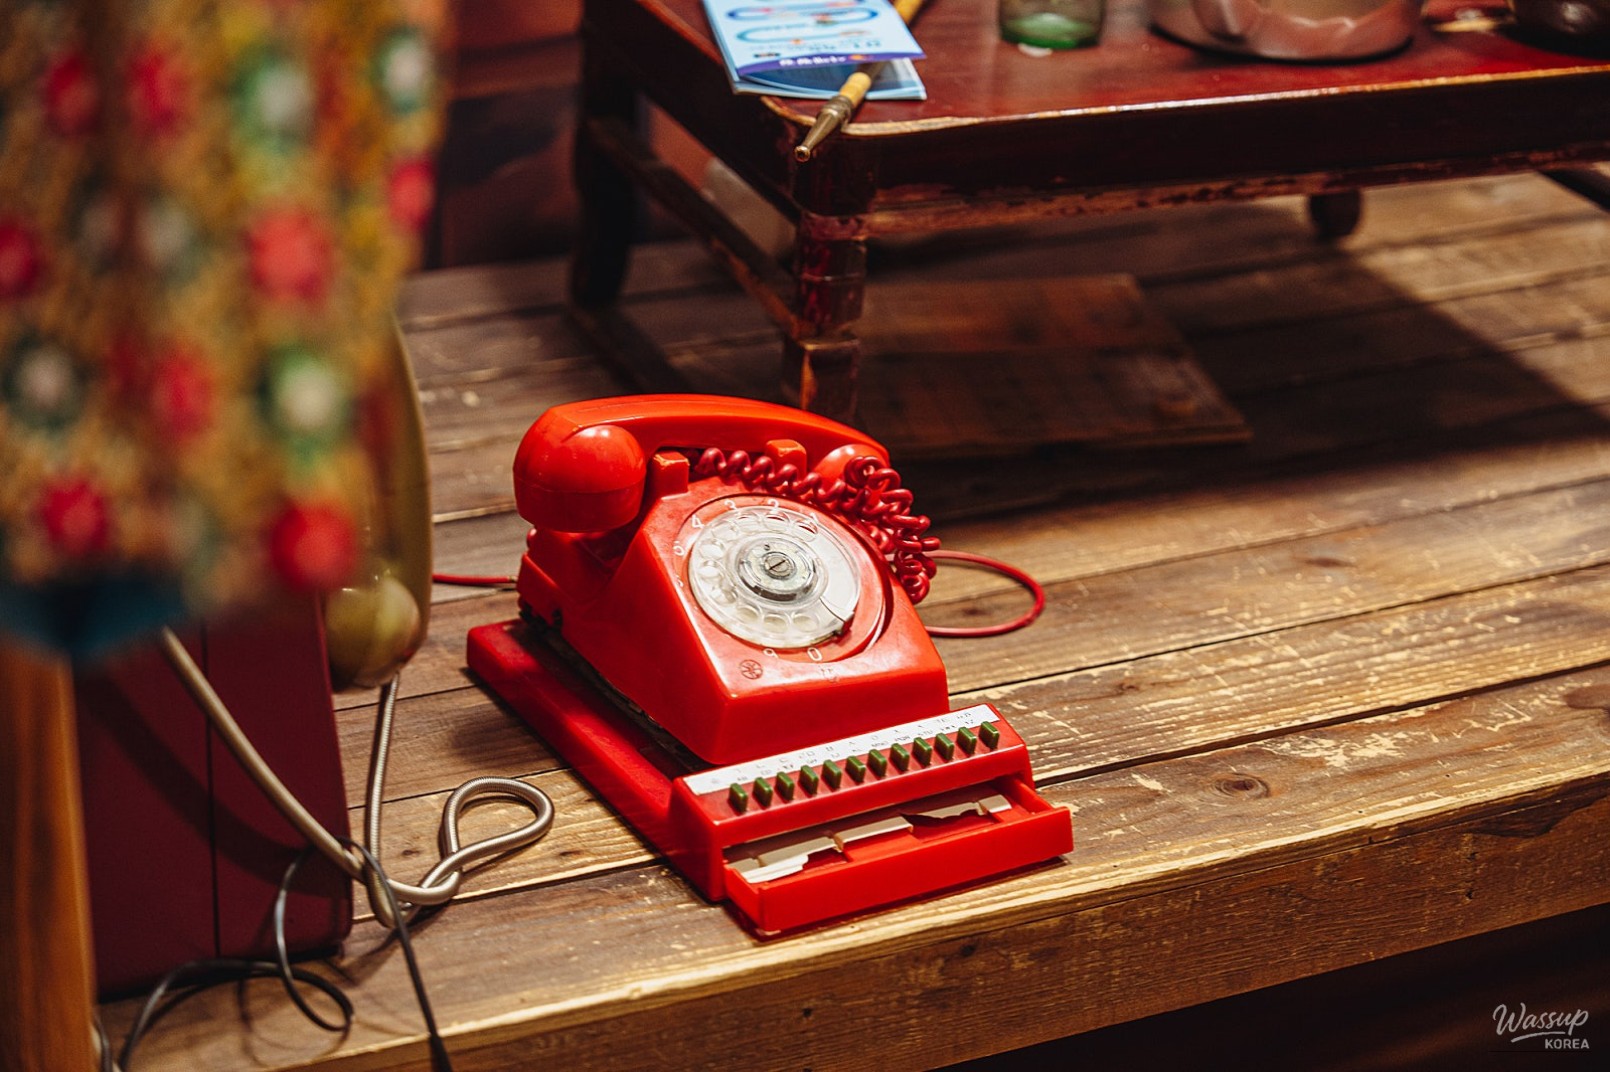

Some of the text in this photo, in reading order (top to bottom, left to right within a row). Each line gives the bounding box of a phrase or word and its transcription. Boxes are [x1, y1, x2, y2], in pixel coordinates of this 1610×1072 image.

[691, 514, 705, 529] 4
[673, 540, 685, 556] 5
[763, 647, 822, 661] 9 0
